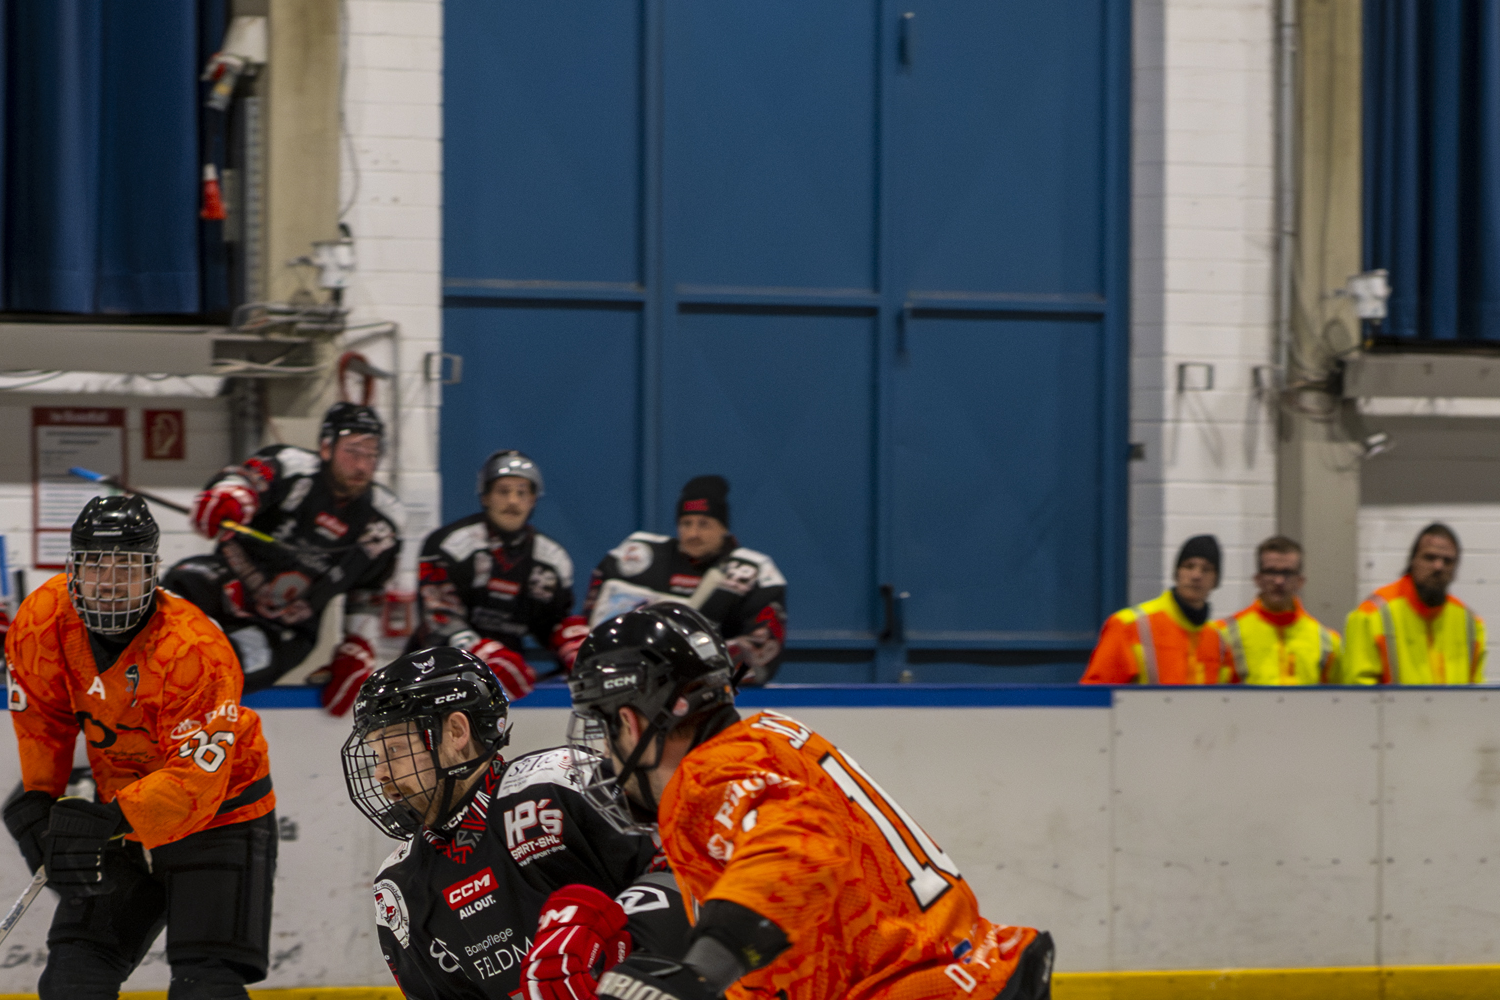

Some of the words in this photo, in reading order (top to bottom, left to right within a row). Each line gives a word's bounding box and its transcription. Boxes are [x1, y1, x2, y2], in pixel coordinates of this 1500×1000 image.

[87, 675, 106, 700] A
[603, 674, 637, 690] CCM
[434, 691, 467, 705] CCM
[449, 874, 491, 905] CCM
[459, 906, 478, 921] ALL
